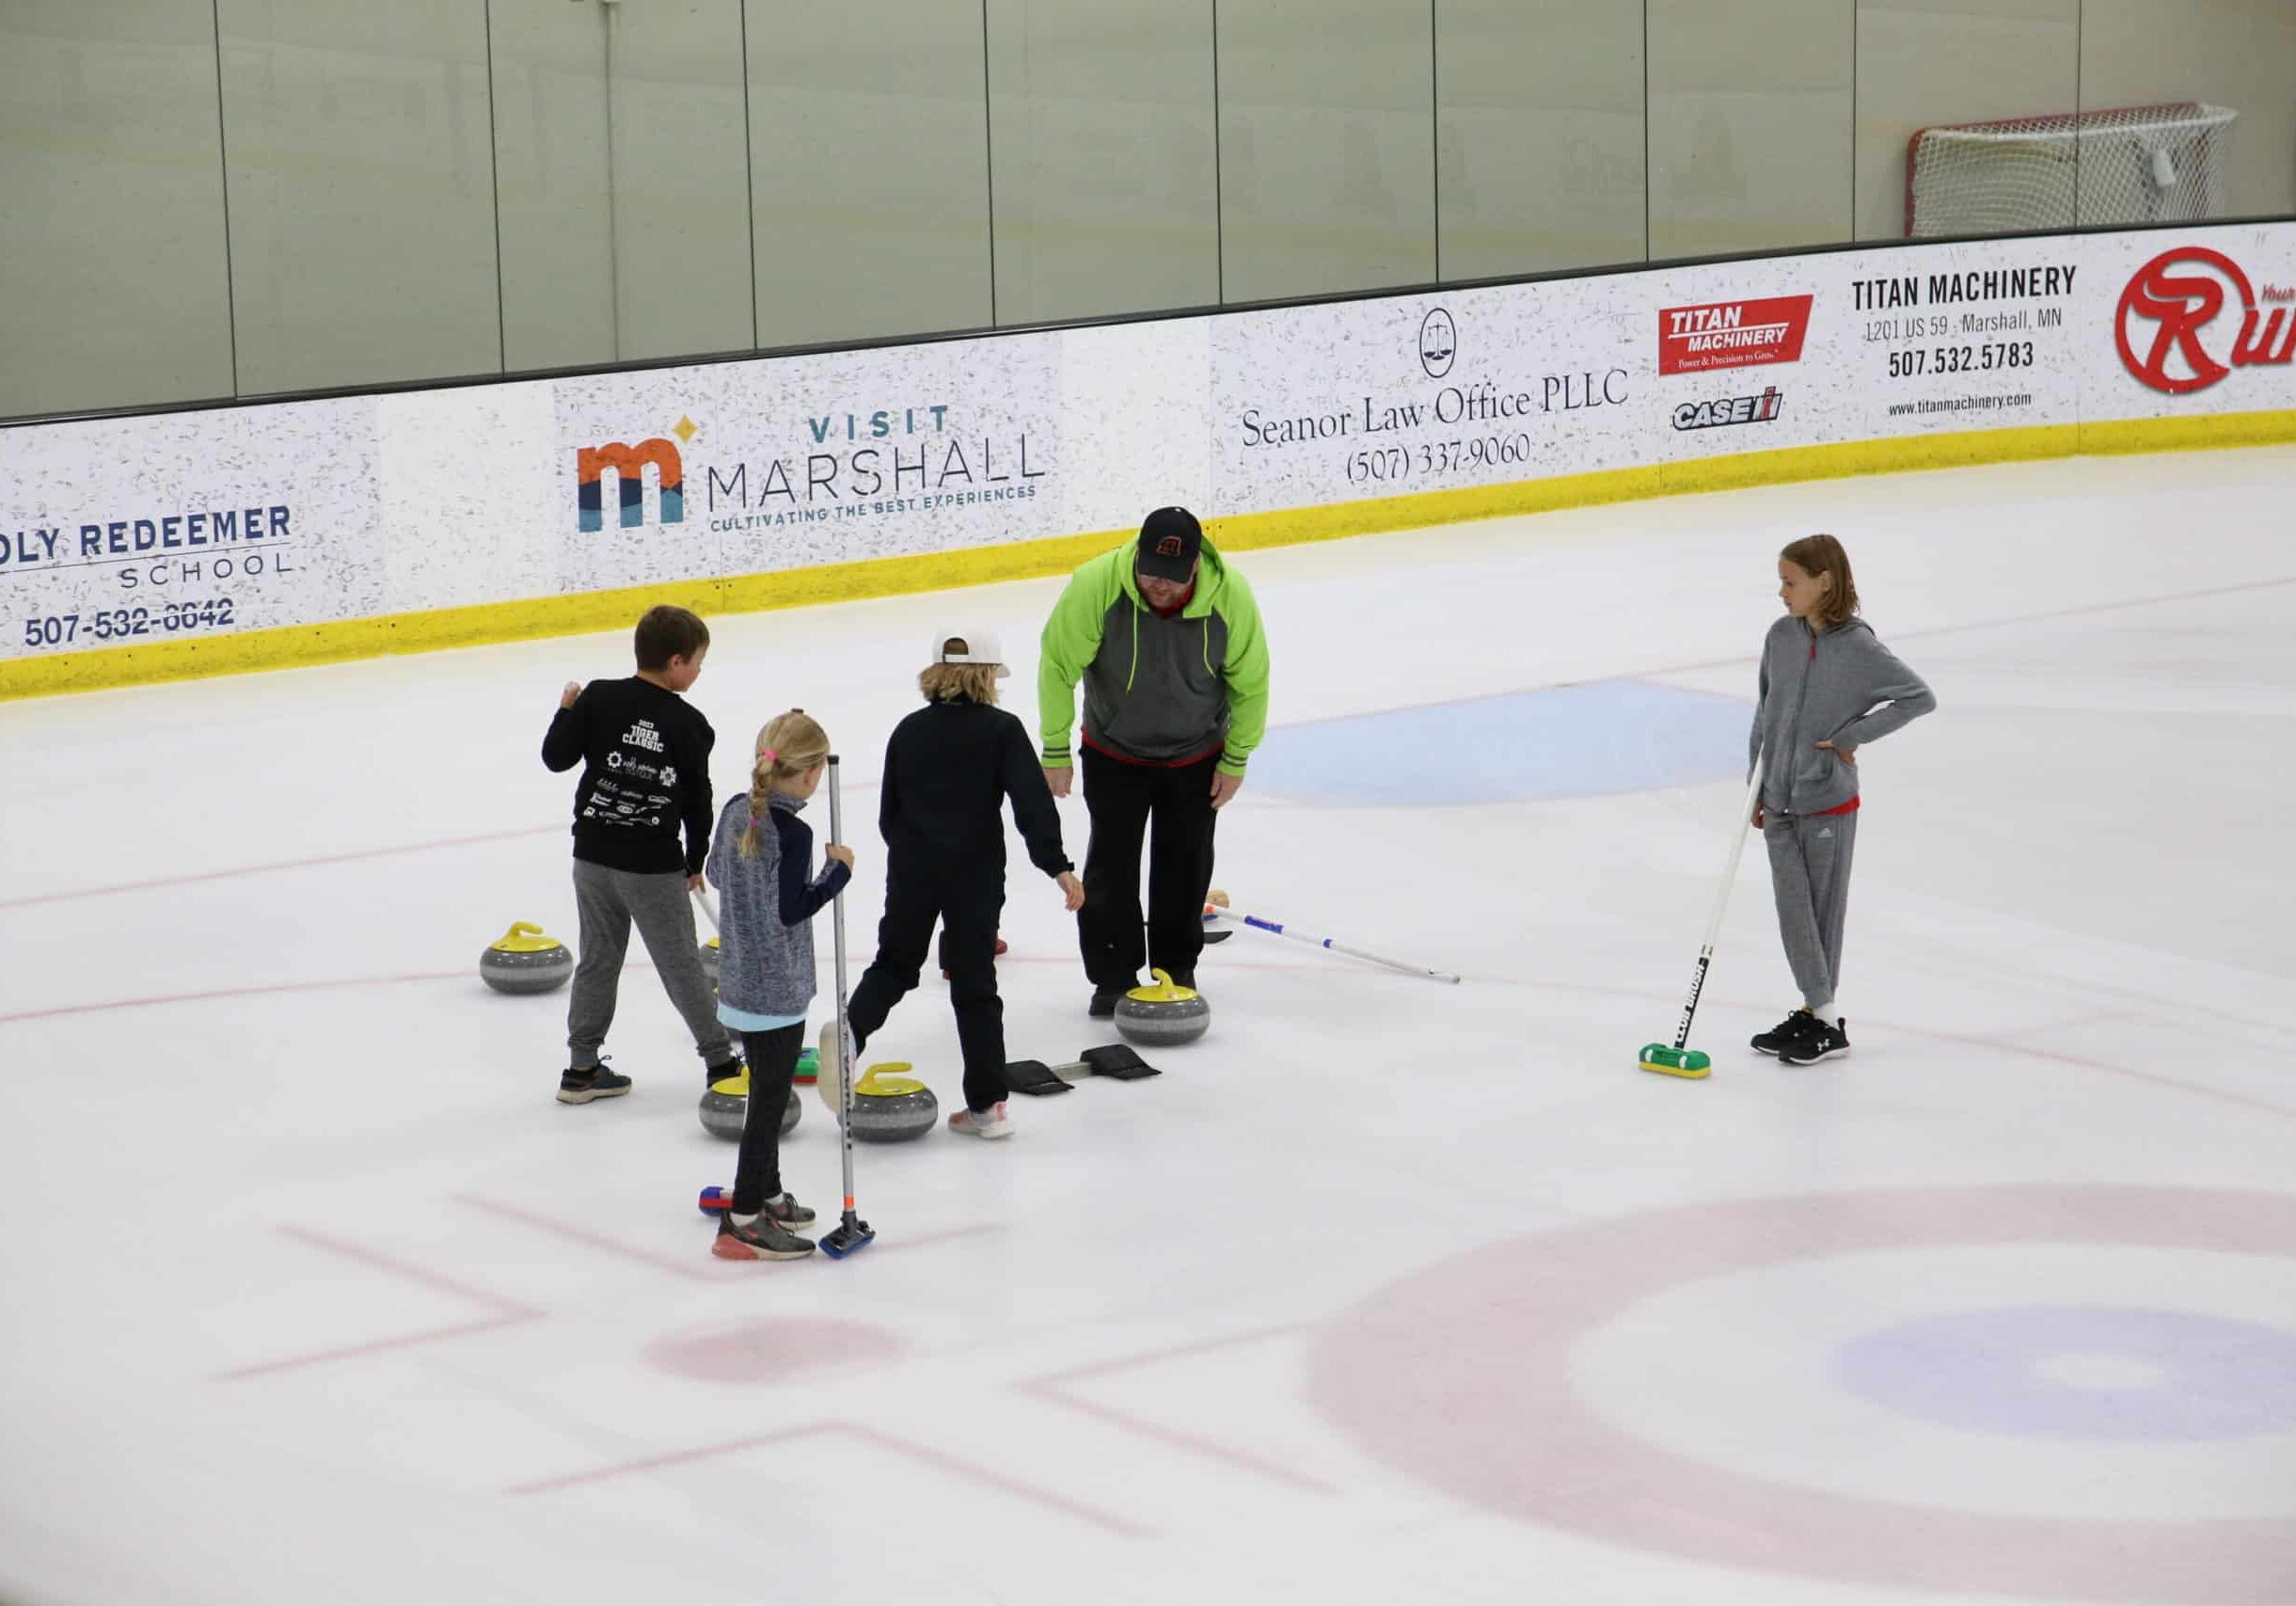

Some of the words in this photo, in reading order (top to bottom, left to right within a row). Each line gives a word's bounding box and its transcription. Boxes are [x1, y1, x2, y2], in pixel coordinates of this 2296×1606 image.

[1852, 276, 1918, 310] TITAN
[1928, 265, 2077, 305] MACHINERY
[1671, 306, 1742, 333] TITAN
[1866, 320, 1899, 342] 1201
[1906, 317, 1924, 338] US
[1930, 315, 1948, 336] 59
[1962, 310, 2032, 334] Marshall,
[2037, 308, 2062, 328] MN
[1688, 327, 1787, 352] MACHINERY
[1889, 342, 2035, 377] 507.532.5783
[1242, 408, 1351, 447] Seanor
[1364, 396, 1425, 433] Law
[1435, 383, 1530, 424] Office
[1542, 369, 1628, 412] PLLC
[1673, 397, 1753, 430] CASE
[1889, 393, 2032, 416] www.titanmachinery.com
[808, 405, 948, 443] VISIT
[708, 433, 1045, 512] MARSHALL
[1346, 447, 1409, 482] (507)
[1420, 434, 1530, 473] 337-9060
[710, 508, 827, 533] CULTIVATING
[835, 503, 867, 518] THE
[874, 499, 916, 515] BEST
[924, 485, 1036, 509] EXPERIENCES
[79, 505, 292, 557] REDEEMER
[119, 551, 293, 589] SCHOOL
[24, 597, 235, 646] 507-532-6642
[622, 733, 664, 753] CLASSIC
